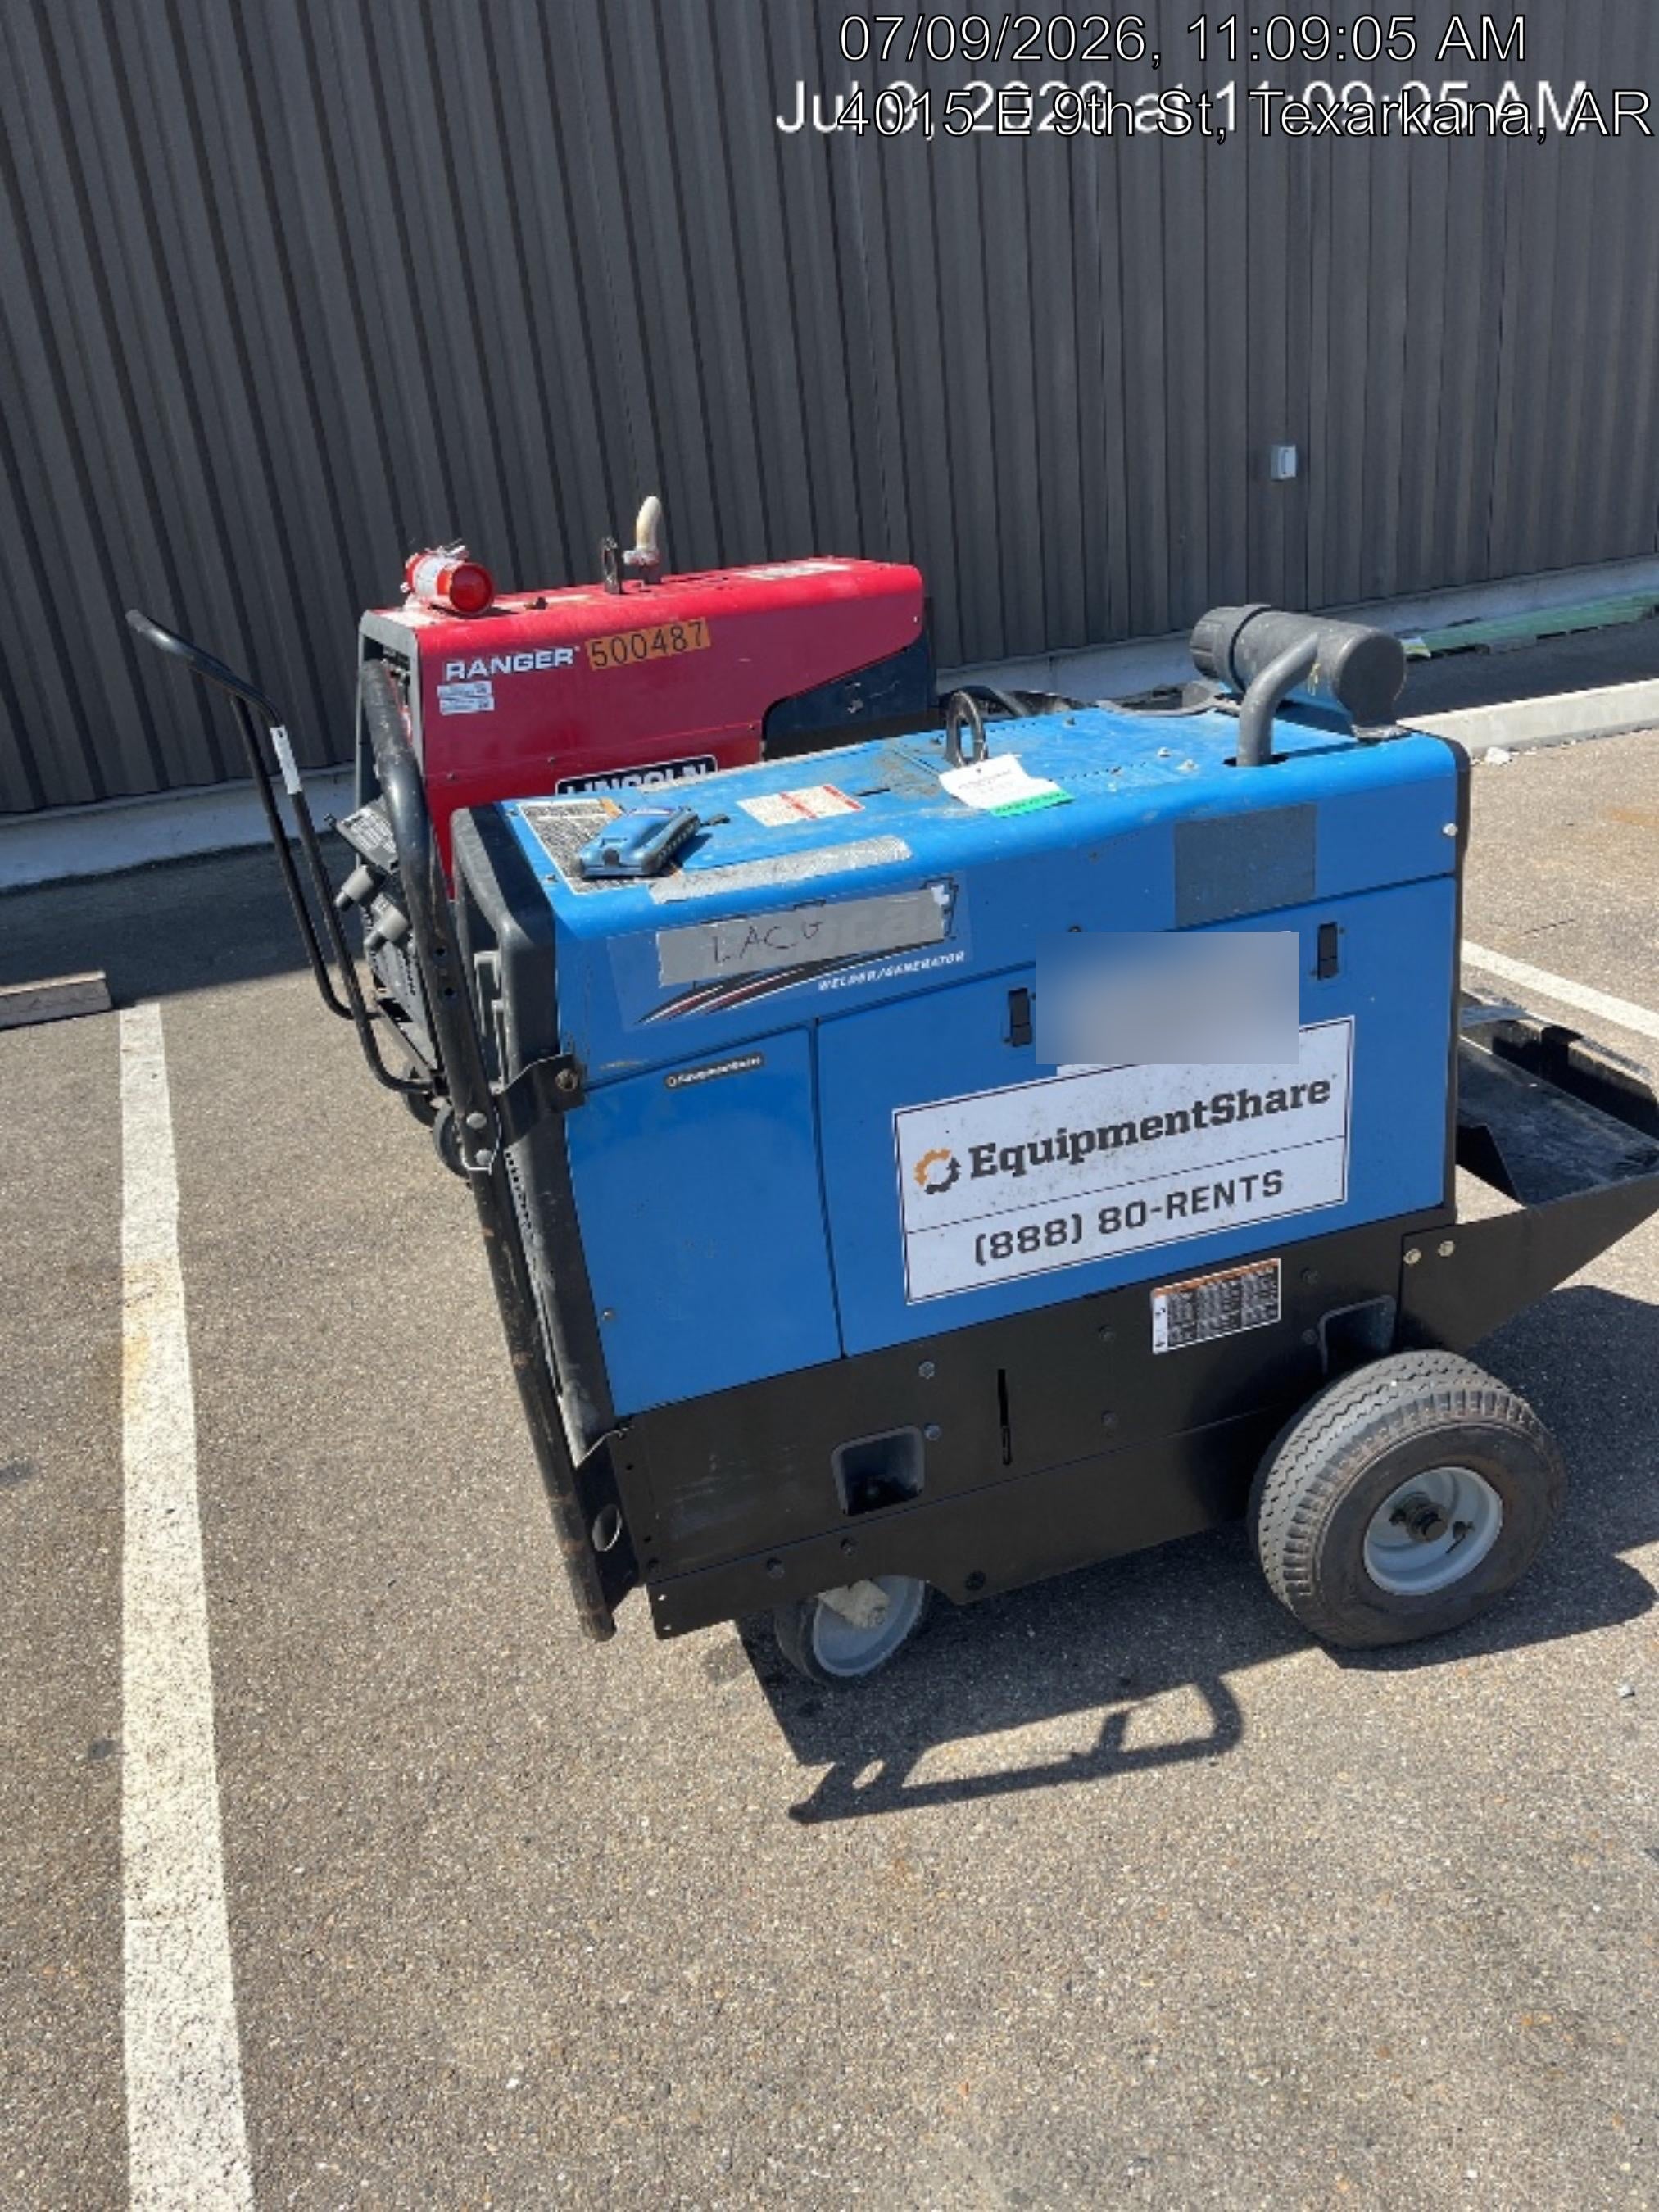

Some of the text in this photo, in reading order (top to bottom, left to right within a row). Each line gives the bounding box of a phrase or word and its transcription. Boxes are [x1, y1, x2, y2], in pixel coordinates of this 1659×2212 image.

[446, 647, 574, 681] RANGER
[589, 620, 705, 669] 500487
[968, 1080, 1331, 1180] EquipmentShare
[975, 1169, 1284, 1266] (888) 80-RENTS
